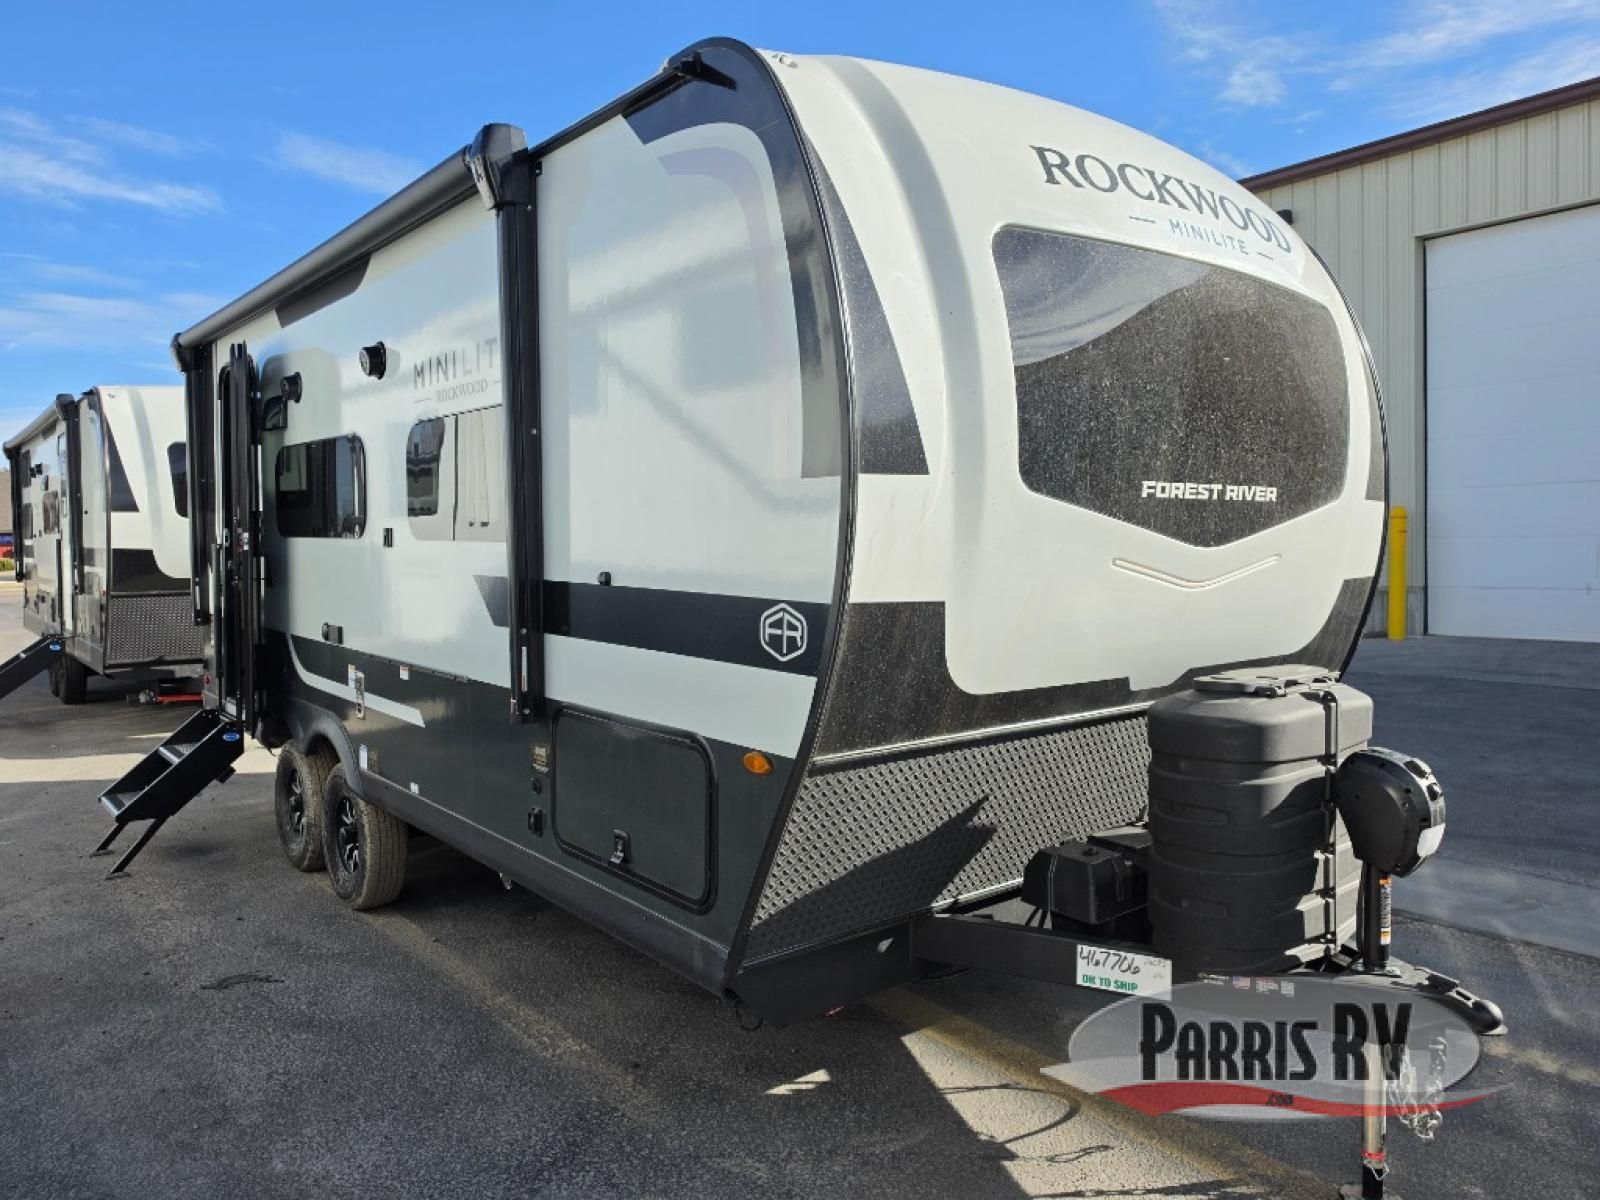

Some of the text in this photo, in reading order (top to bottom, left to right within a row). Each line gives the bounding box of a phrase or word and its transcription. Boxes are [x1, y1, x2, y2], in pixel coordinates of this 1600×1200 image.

[1028, 145, 1291, 253] ROCKWOOD
[1168, 218, 1249, 255] MINILITE
[413, 336, 498, 390] MINILIT
[435, 379, 488, 403] ROCKWOOD
[1141, 480, 1278, 502] FOREST RIVER
[1079, 946, 1141, 975] 467706
[1082, 974, 1138, 992] OK TO SHIP
